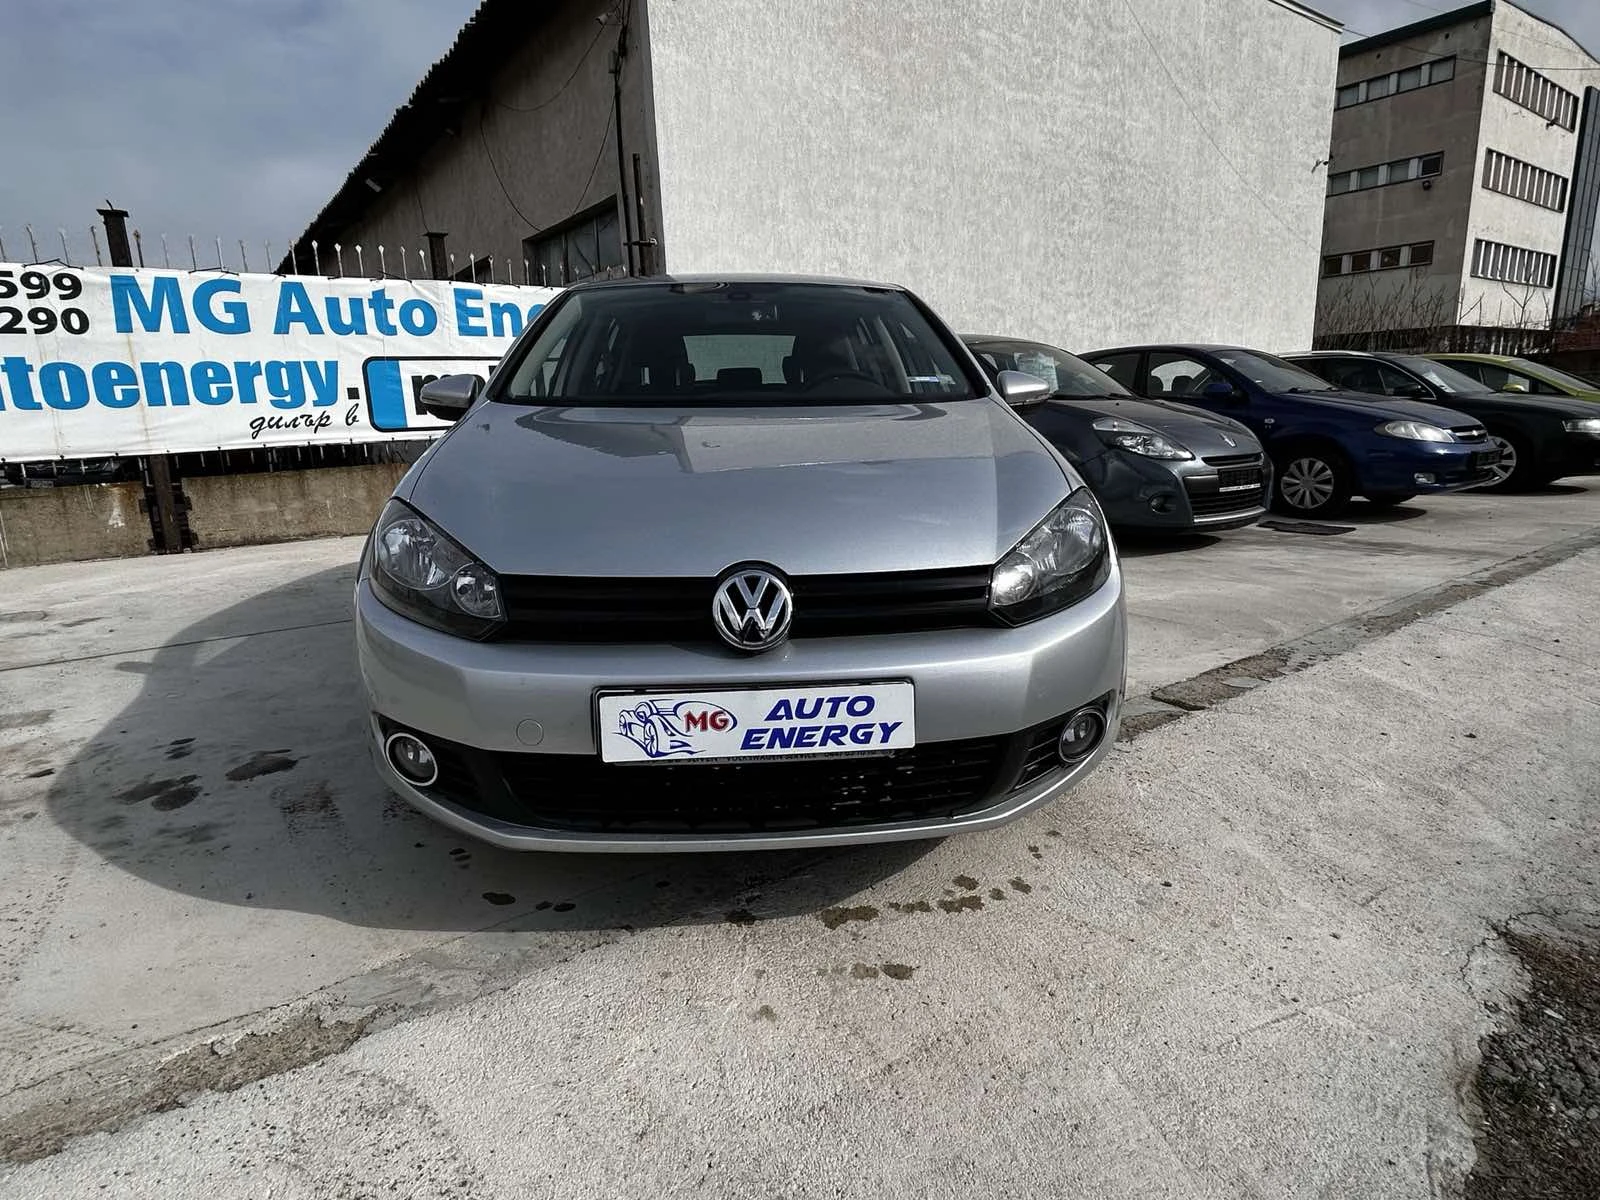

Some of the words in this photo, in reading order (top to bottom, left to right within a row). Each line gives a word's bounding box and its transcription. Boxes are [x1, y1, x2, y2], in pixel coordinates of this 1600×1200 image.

[0, 306, 90, 335] 290
[110, 275, 251, 335] MG
[274, 281, 437, 337] Auto
[453, 287, 547, 337] En
[0, 356, 360, 411] toenergy.
[250, 413, 332, 439] дилър
[345, 403, 360, 426] в
[684, 709, 729, 732] MG
[764, 695, 875, 721] AUTO
[740, 721, 903, 750] ENERGY
